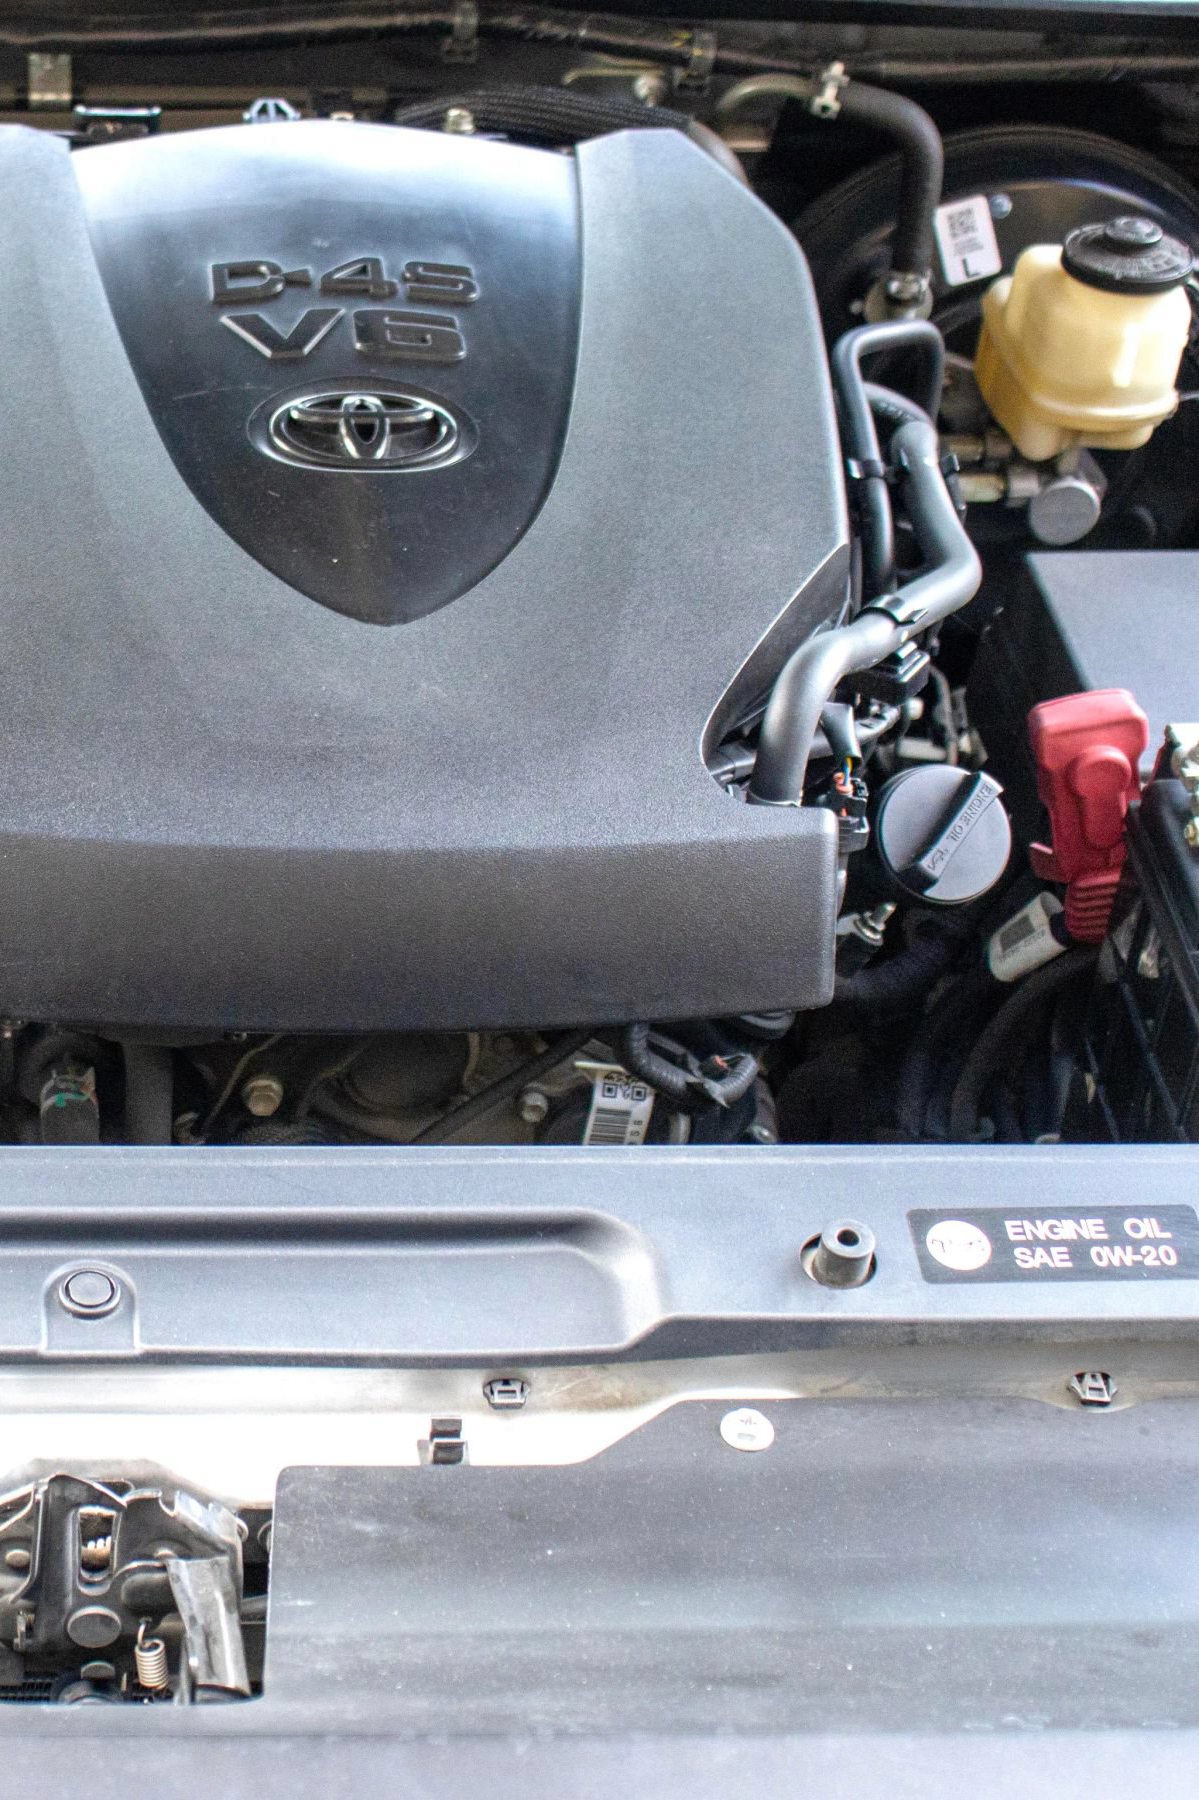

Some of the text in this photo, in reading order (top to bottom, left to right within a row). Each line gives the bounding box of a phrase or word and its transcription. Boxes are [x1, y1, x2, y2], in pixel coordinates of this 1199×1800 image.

[209, 256, 481, 304] D-4S
[962, 257, 981, 278] L
[219, 307, 468, 361] V6
[946, 783, 994, 842] ENGINE OIL
[1004, 1217, 1173, 1241] ENGINE OIL
[1013, 1245, 1178, 1269] SAE 0W-20
